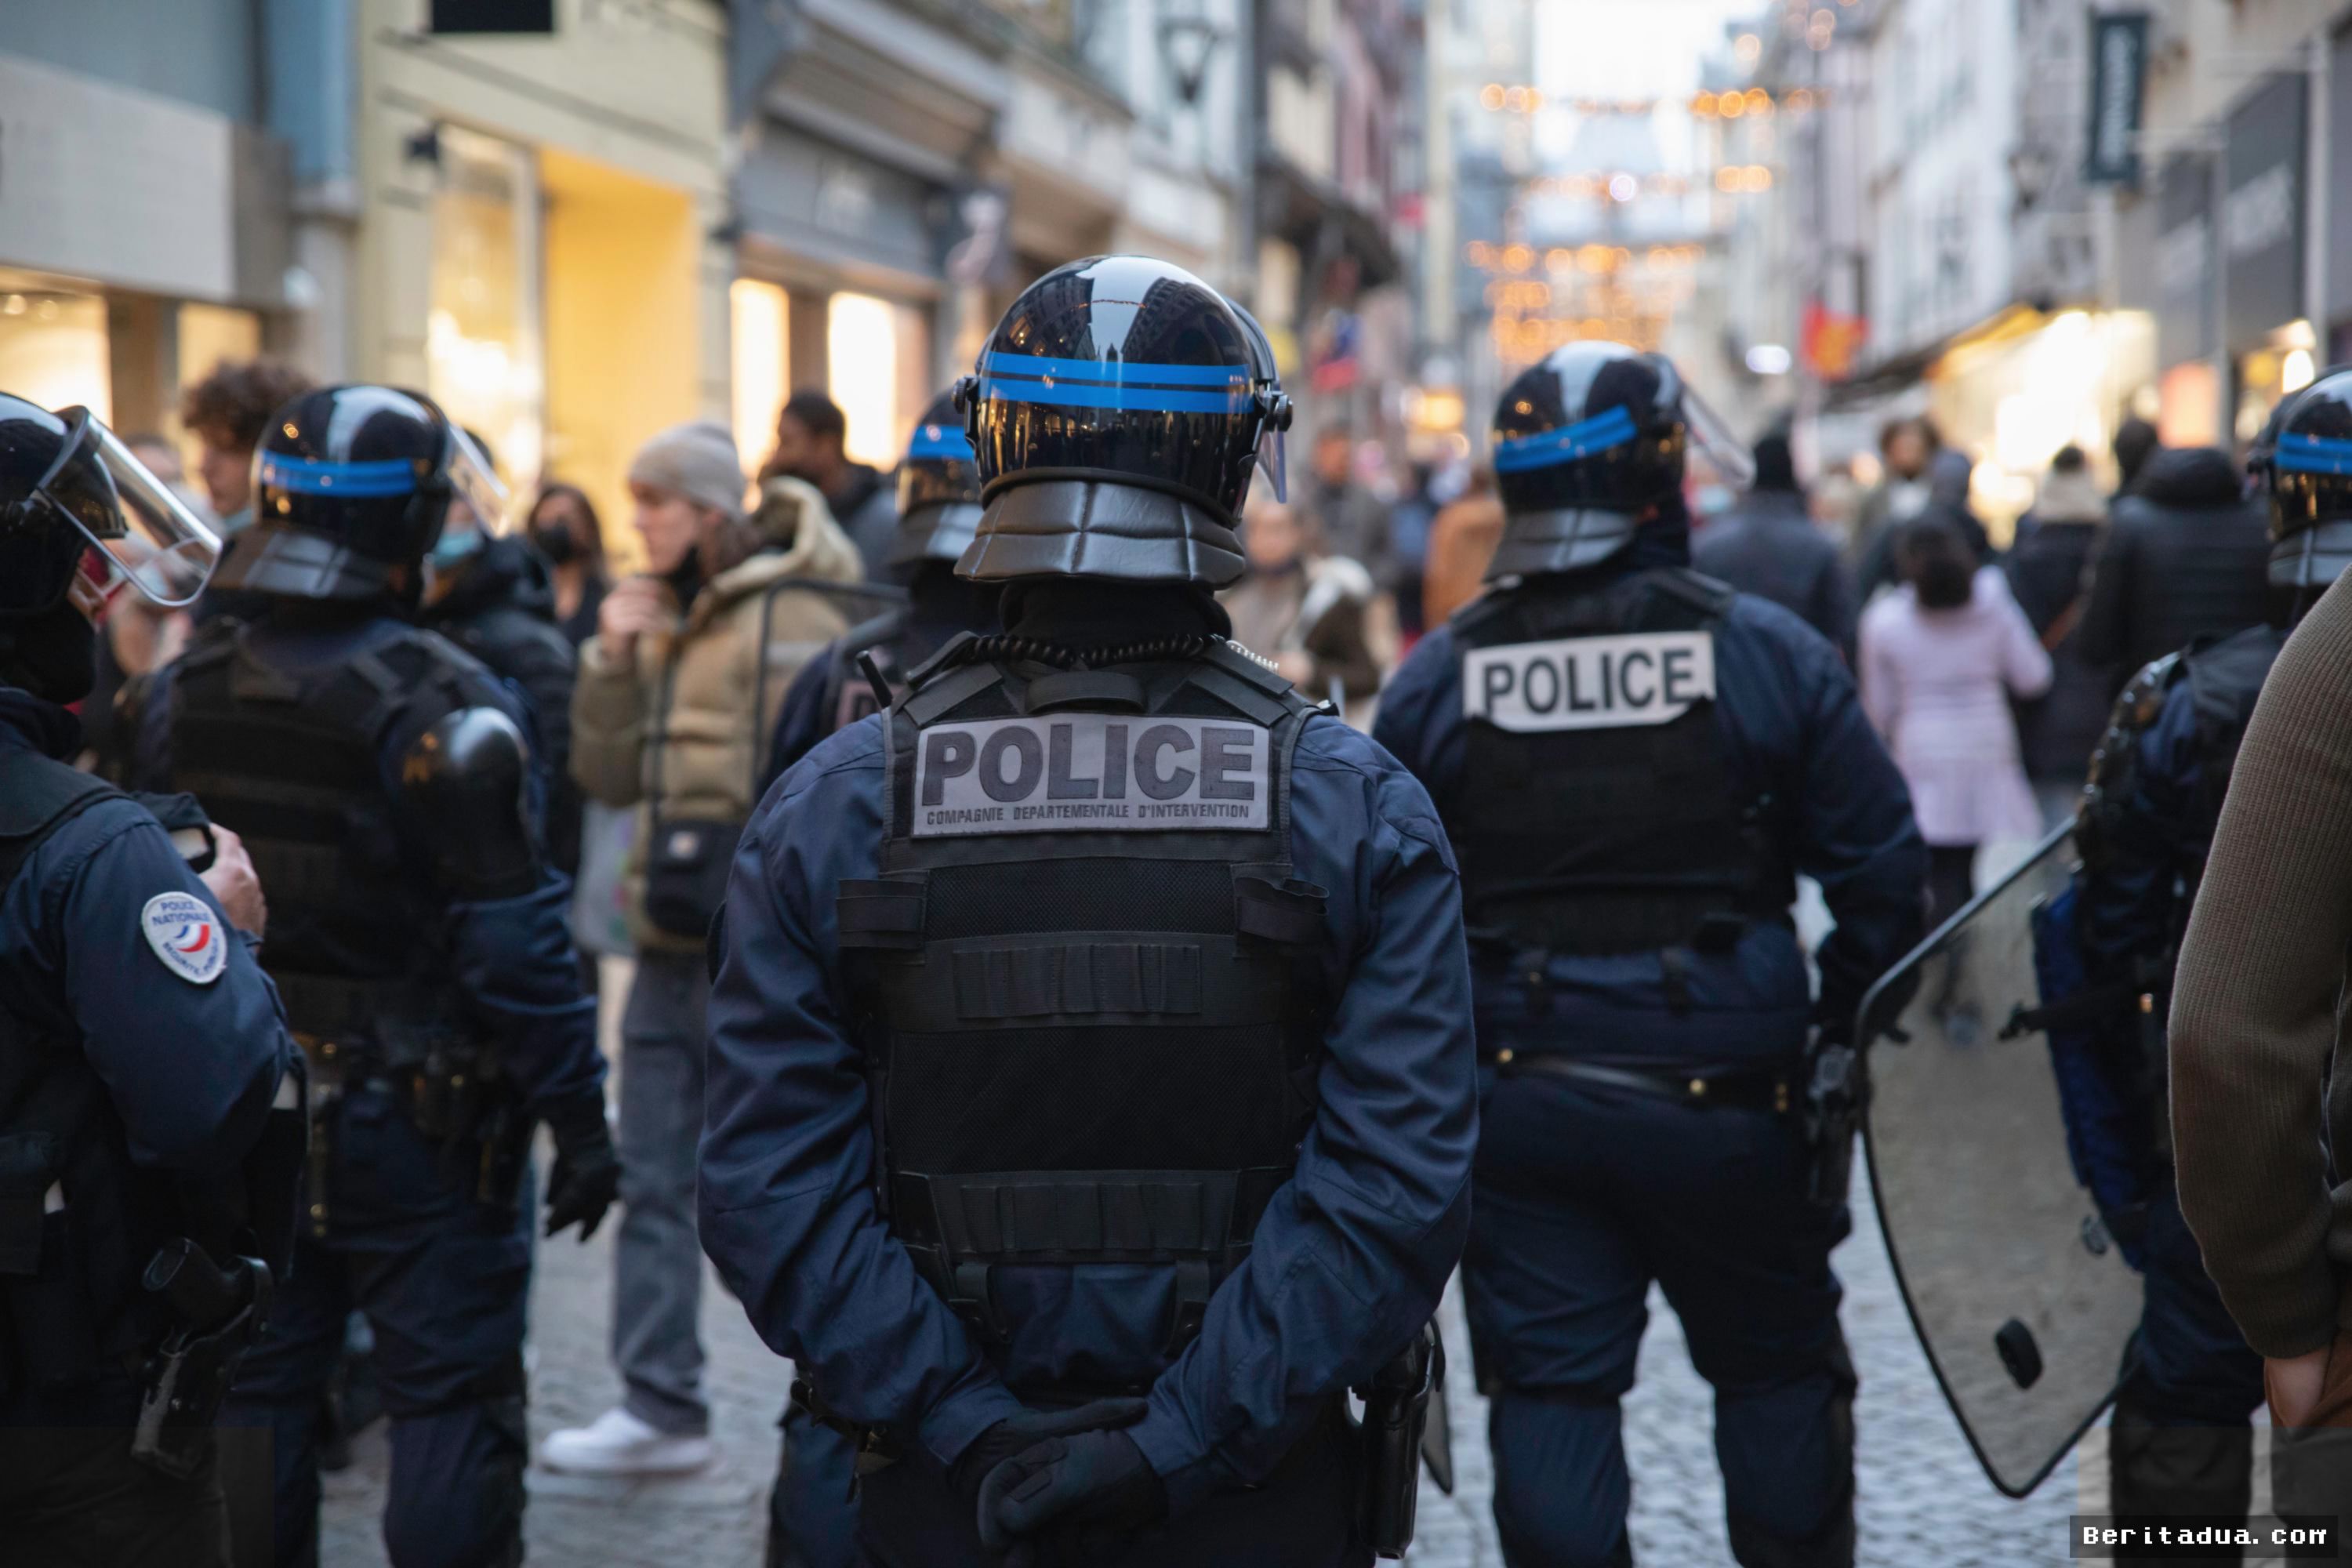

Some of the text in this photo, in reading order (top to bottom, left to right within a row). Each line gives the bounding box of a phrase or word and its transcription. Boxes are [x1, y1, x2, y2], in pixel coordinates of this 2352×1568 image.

[1483, 648, 1693, 717] POLICE
[923, 724, 1254, 805] POLICE
[927, 804, 1249, 825] COMPAGNIE DEPARTEMENTALE D'INTERVENTION
[161, 901, 195, 911] POLICE
[151, 913, 210, 925] NATIONALE
